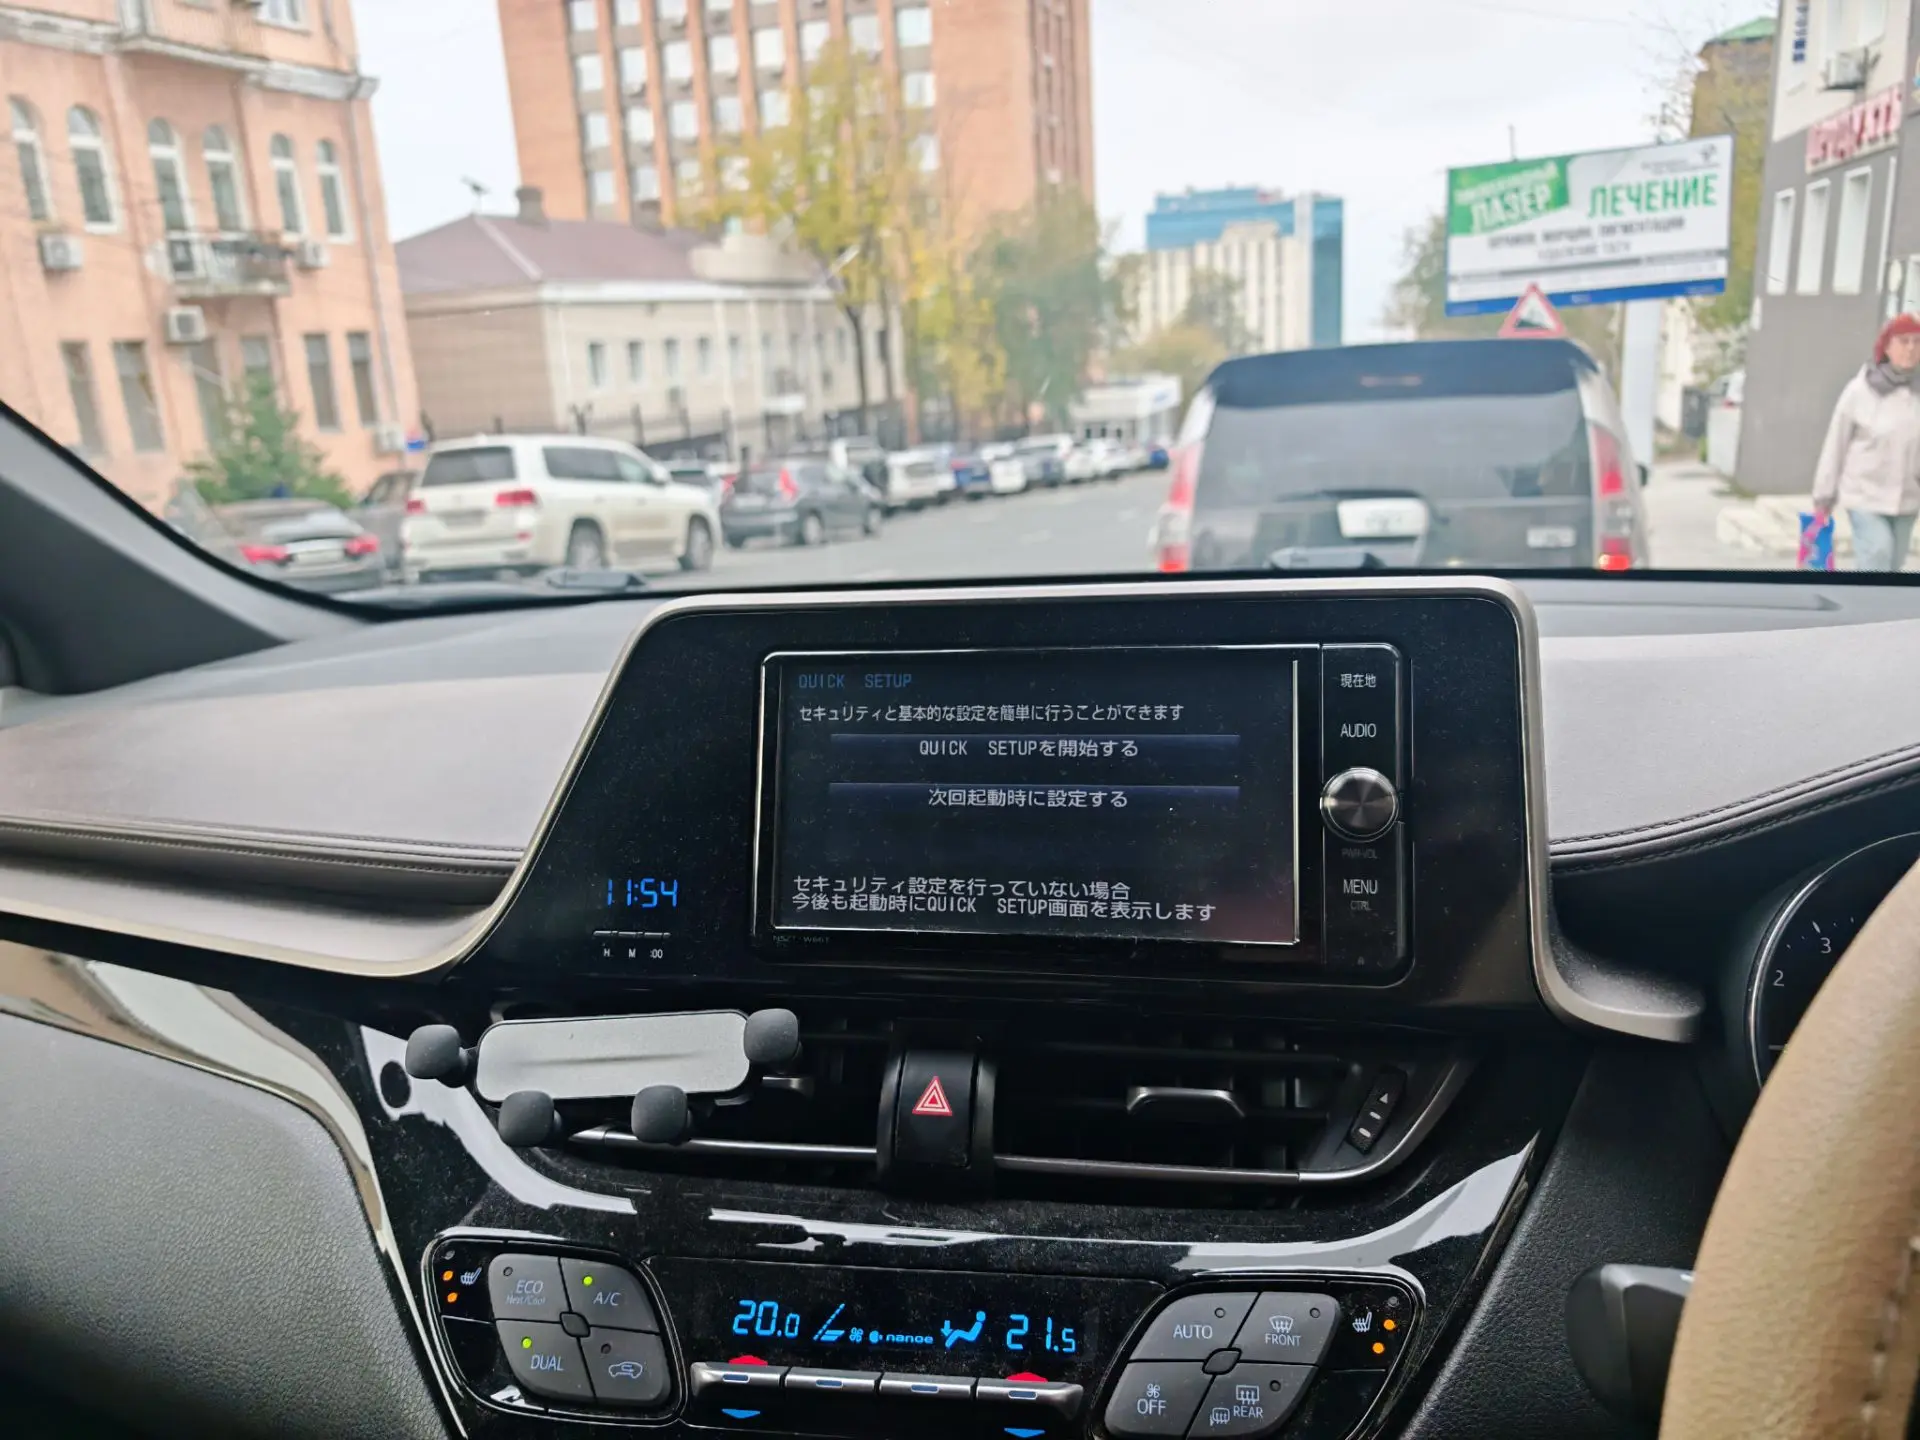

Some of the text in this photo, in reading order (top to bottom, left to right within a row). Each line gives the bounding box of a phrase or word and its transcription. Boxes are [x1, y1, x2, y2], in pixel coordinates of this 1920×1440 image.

[1588, 174, 1718, 219] ЛЕЧЕНИЕ
[1470, 186, 1552, 232] ЛАЗЕР
[798, 674, 912, 688] QUICK SETUP
[1340, 673, 1376, 688] 現在地
[799, 704, 1184, 722] セキュリティと基本的な設定を簡単に行うことができます
[1340, 723, 1377, 738] AUDIO
[919, 739, 1139, 758] QUICK SETUPを開始する
[928, 788, 1128, 808] 次回起動時に設定する
[607, 878, 678, 908] 11:54
[793, 876, 1131, 900] セキュリティ設定を行っていない場合
[1343, 879, 1378, 895] MENU
[792, 893, 1216, 921] 今後も起動時にQUICK SETUP画面を表示します
[1350, 901, 1371, 911] CTRL
[604, 949, 611, 957] H
[628, 949, 636, 958] M
[1820, 937, 1831, 954] 3
[1773, 970, 1784, 986] 2
[515, 1280, 544, 1294] ECO
[593, 1292, 621, 1305] A/C
[732, 1300, 800, 1338] 20.0
[885, 1332, 934, 1345] nanoe
[1006, 1313, 1076, 1353] 21.5
[1173, 1324, 1213, 1339] AUTO
[1265, 1333, 1302, 1347] FRONT
[530, 1355, 564, 1371] DUAL
[1137, 1398, 1168, 1416] OFF
[1233, 1405, 1264, 1420] REAR
